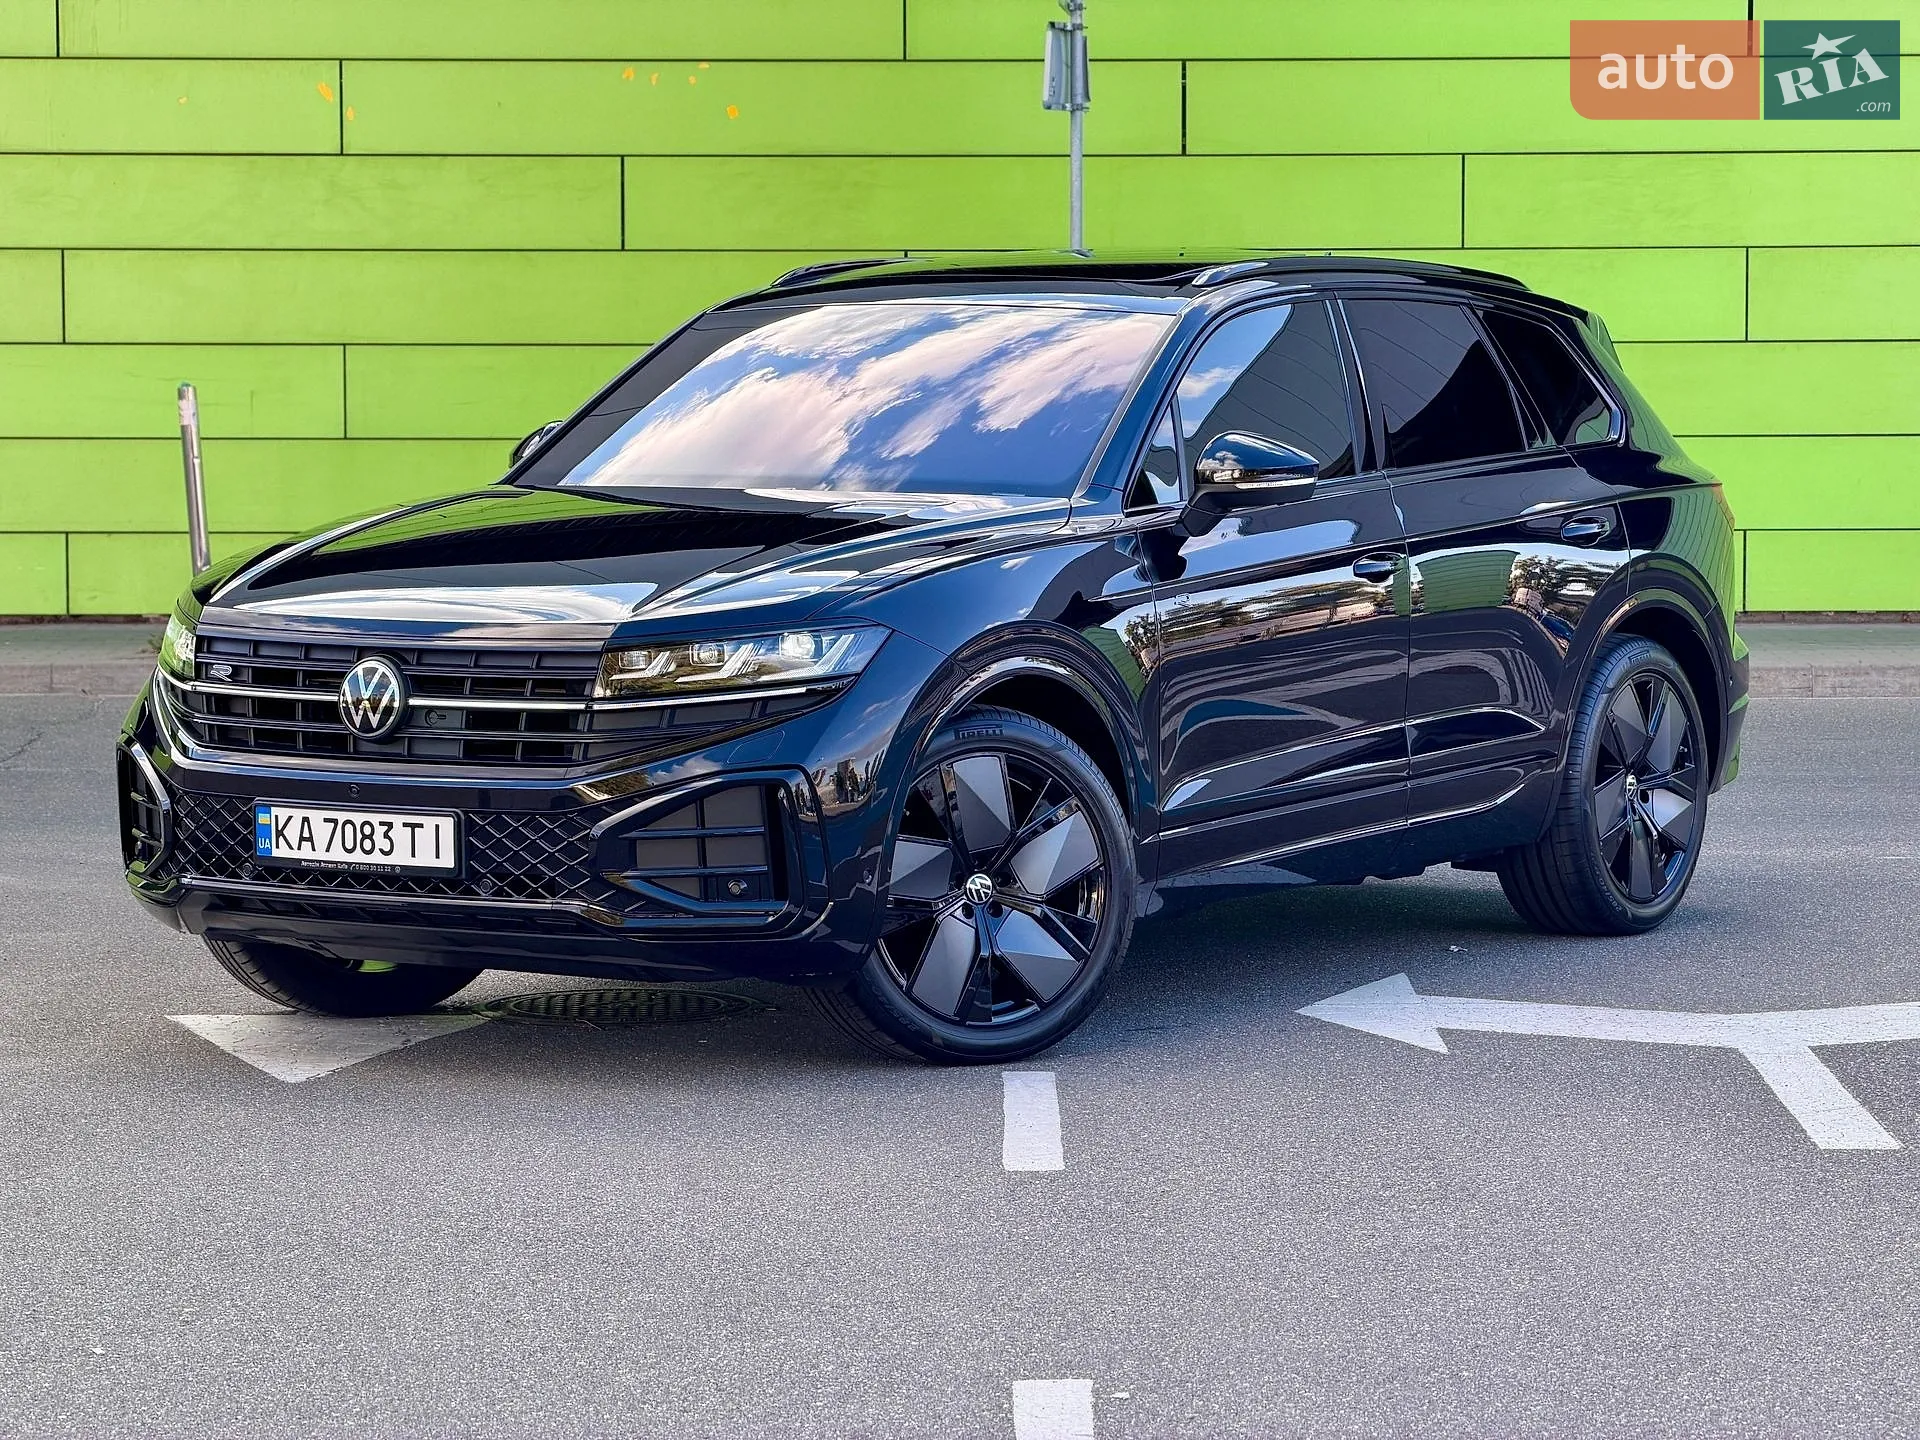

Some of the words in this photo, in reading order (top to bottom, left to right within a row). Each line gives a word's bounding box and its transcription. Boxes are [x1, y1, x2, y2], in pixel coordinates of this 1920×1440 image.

[258, 837, 271, 849] UA
[274, 814, 316, 852] KA
[322, 817, 395, 857] 7083
[402, 822, 440, 860] TI
